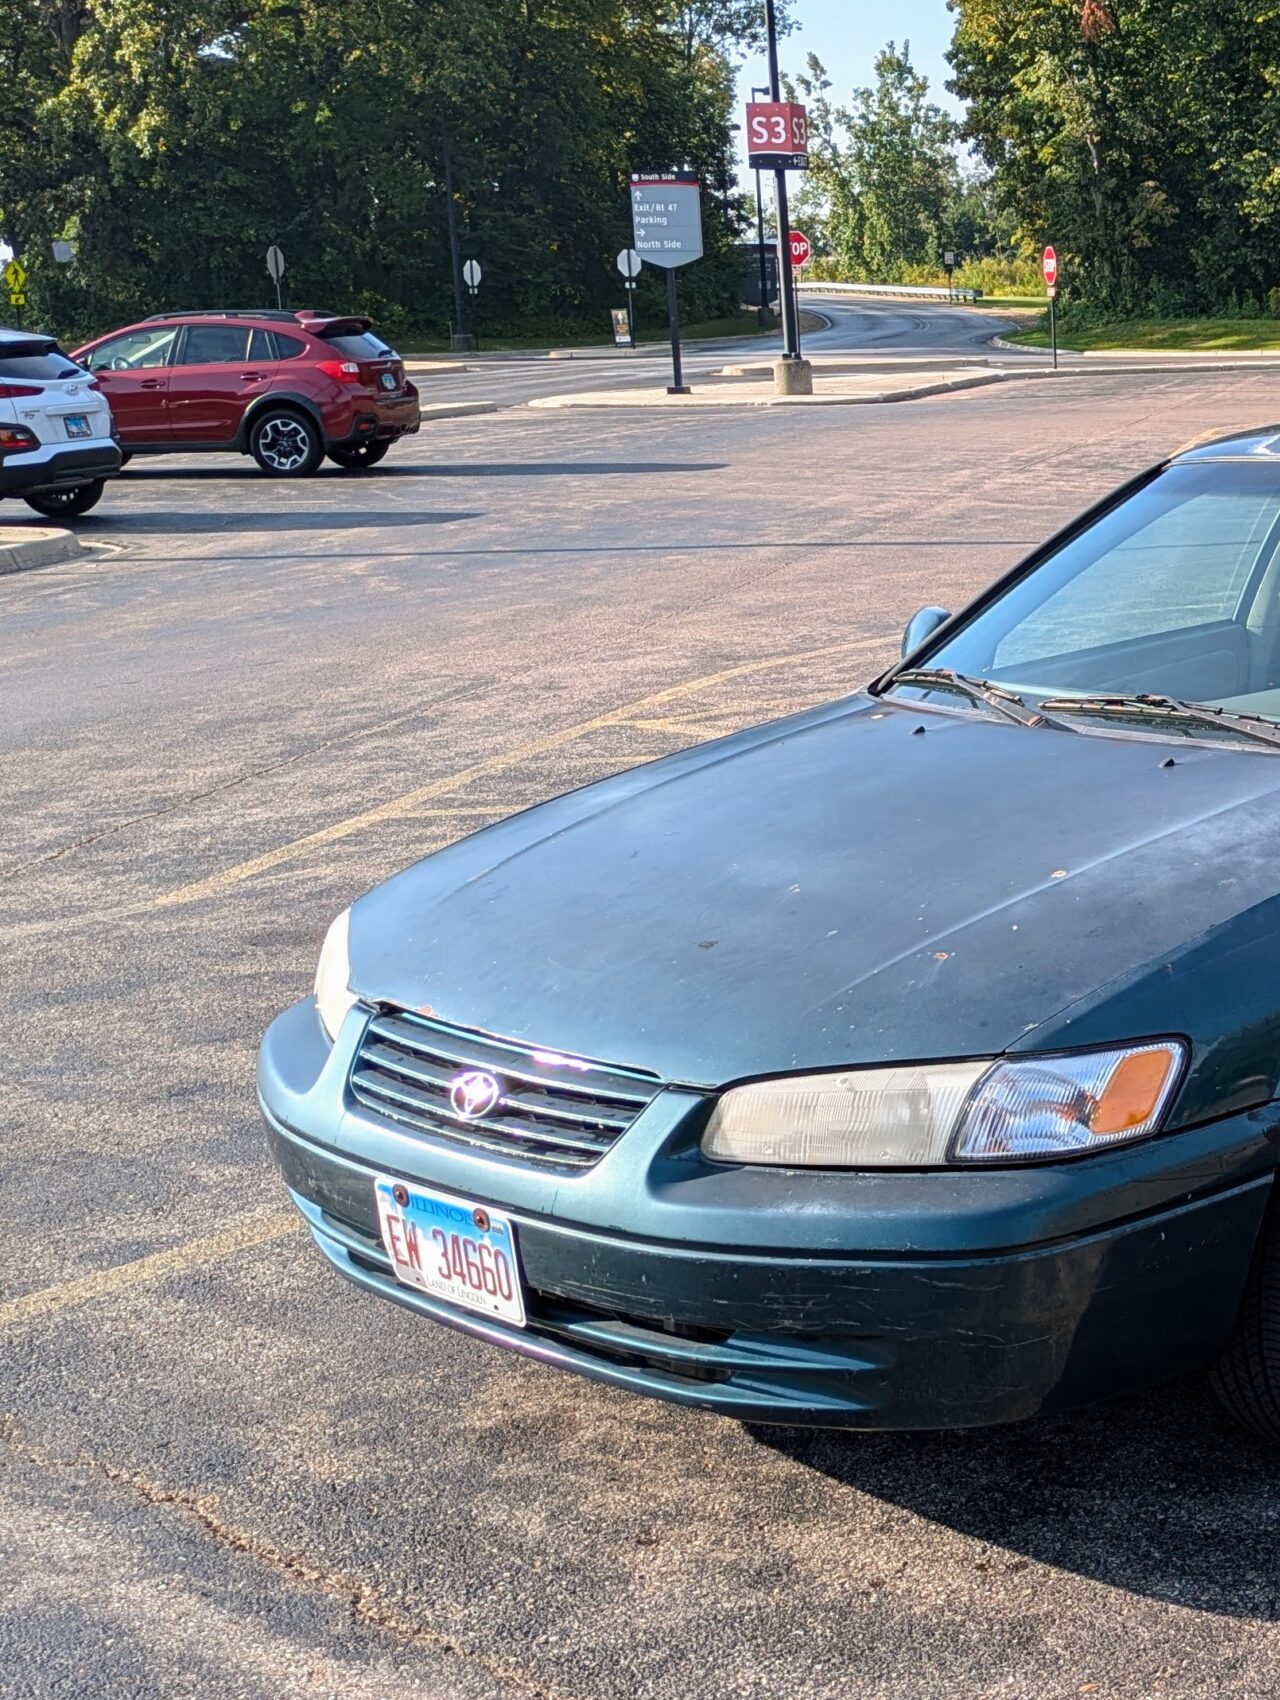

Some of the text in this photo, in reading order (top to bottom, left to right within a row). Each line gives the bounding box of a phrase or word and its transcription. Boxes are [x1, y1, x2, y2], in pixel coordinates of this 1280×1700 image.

[752, 116, 786, 144] S3
[792, 116, 806, 145] S3
[667, 203, 678, 212] 47
[635, 216, 668, 226] Parking
[637, 240, 682, 249] North Side
[791, 242, 808, 256] OP
[386, 1213, 513, 1302] EW 34660
